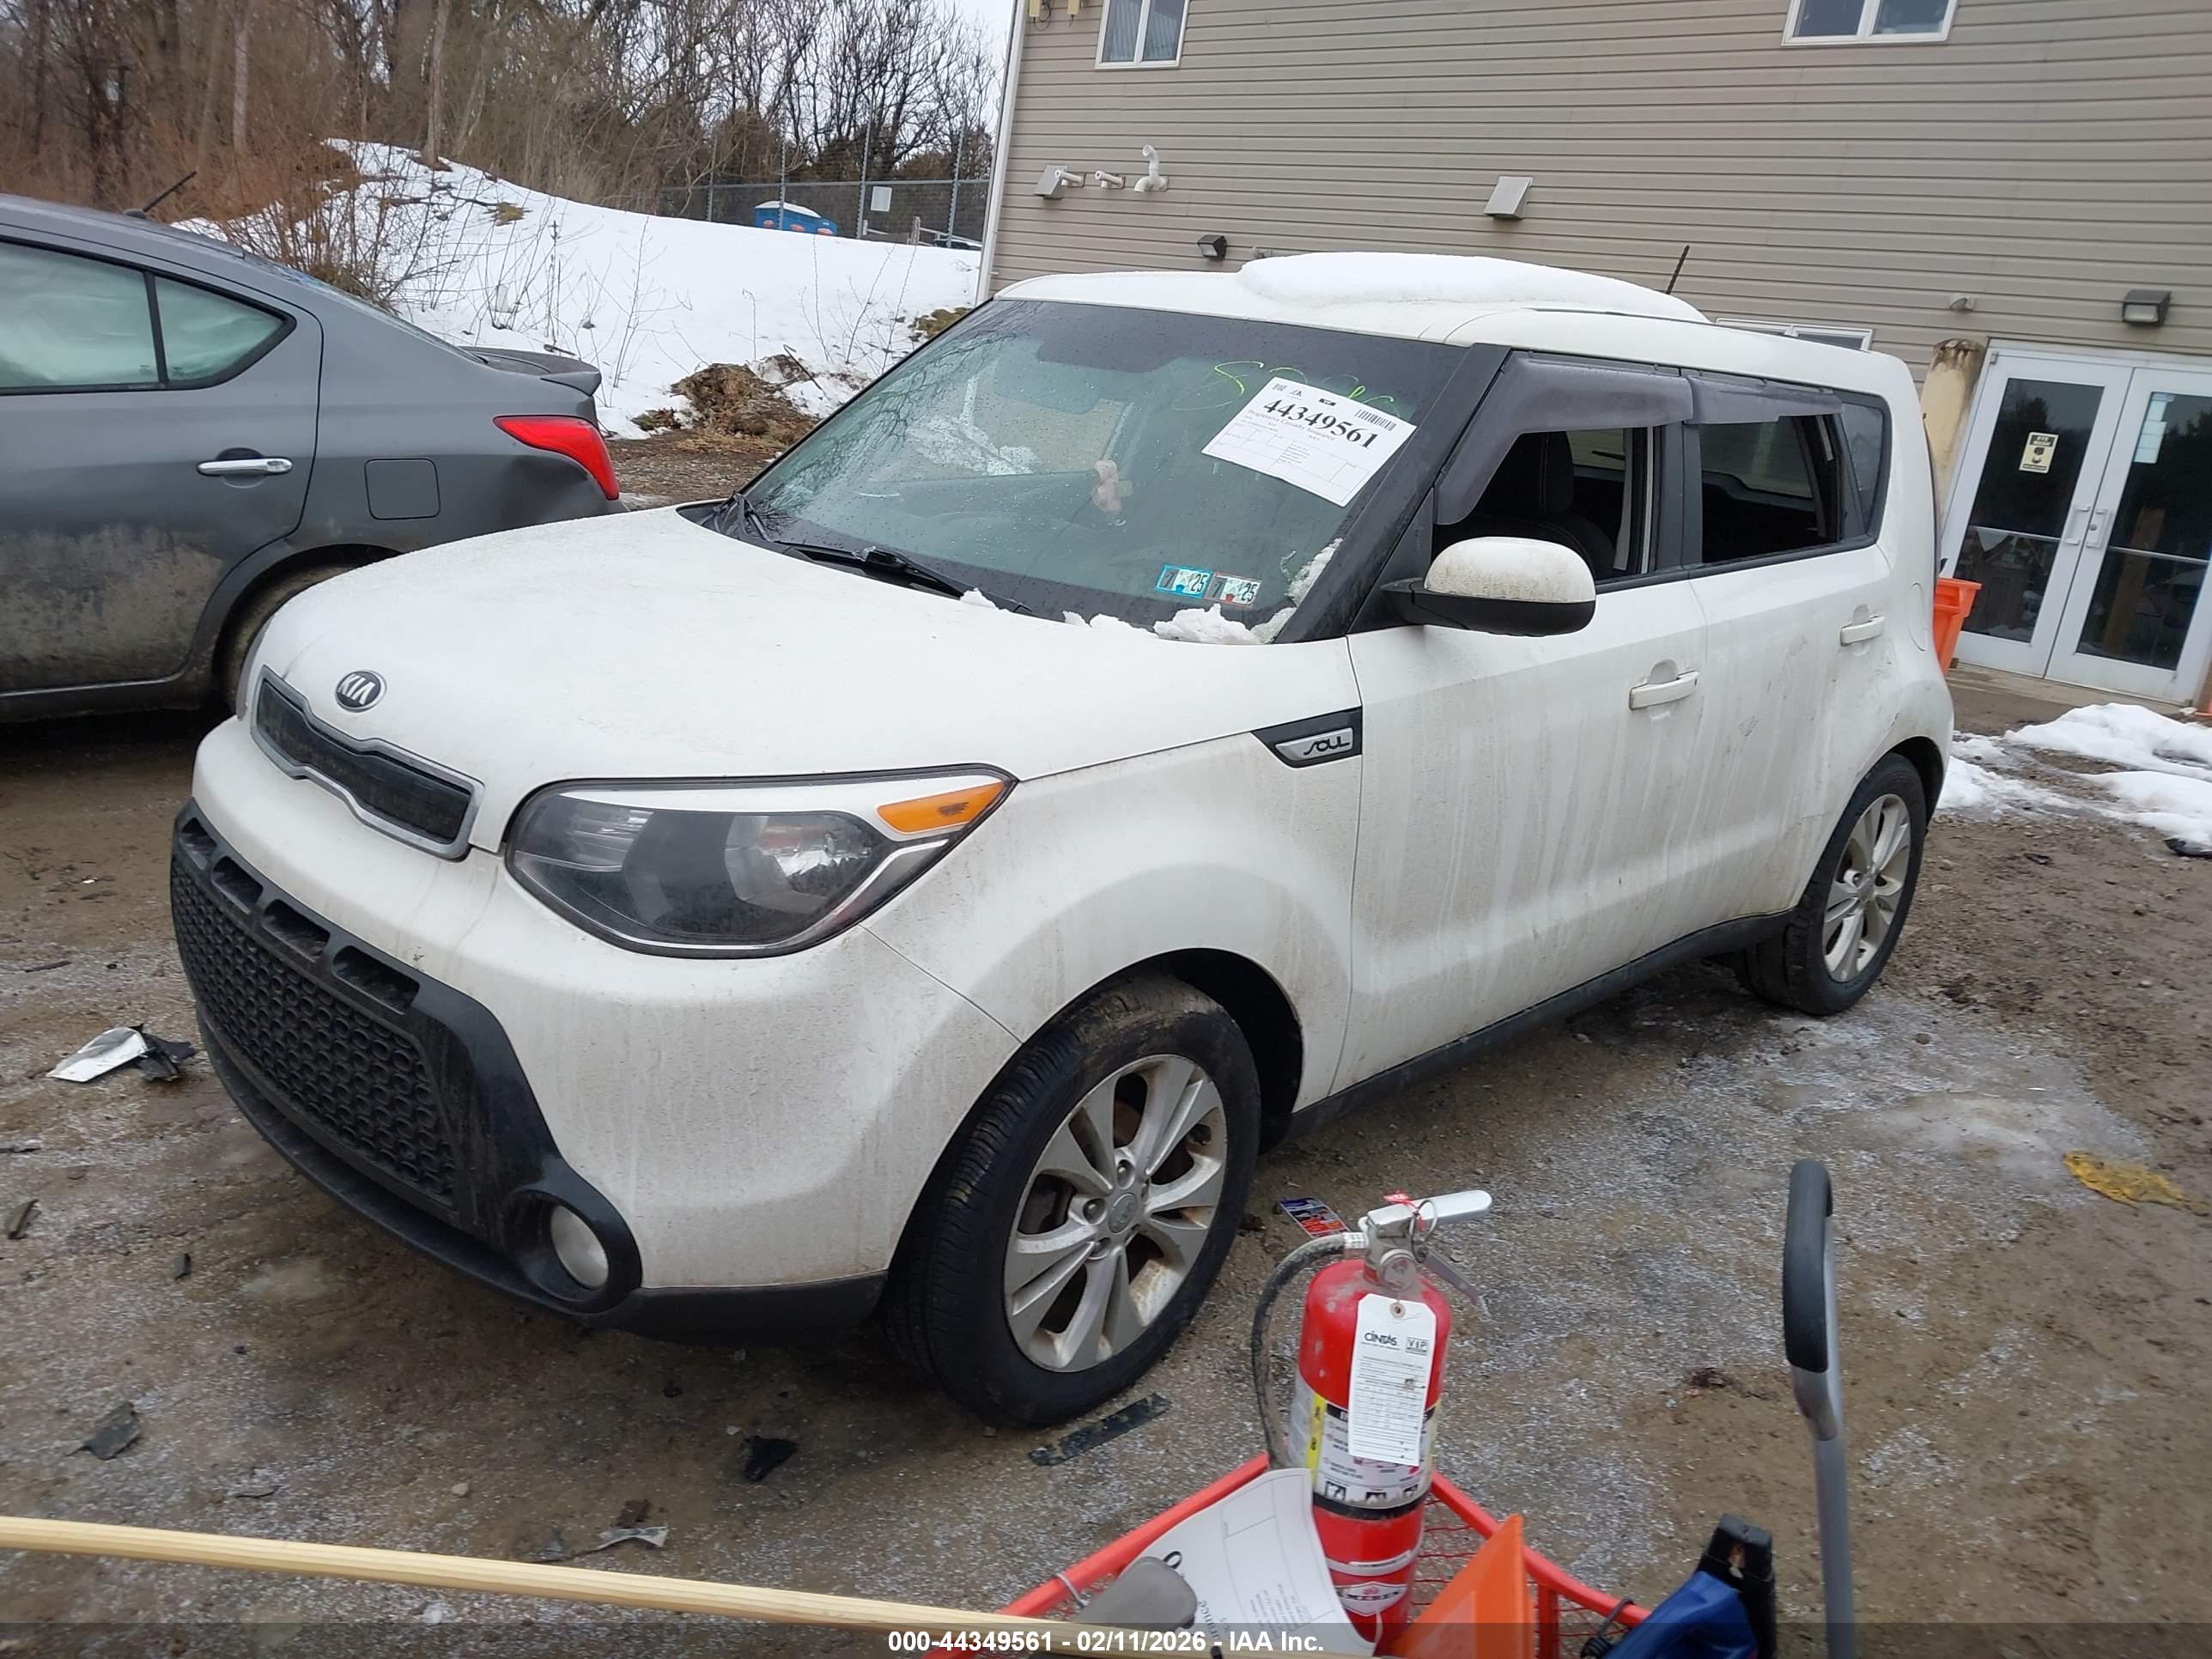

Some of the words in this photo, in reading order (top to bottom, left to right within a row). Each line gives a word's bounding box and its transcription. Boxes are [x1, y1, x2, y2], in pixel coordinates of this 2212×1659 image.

[1263, 399, 1377, 448] 44349561
[1191, 574, 1207, 592] 25
[1242, 582, 1257, 603] 25
[1407, 1339, 1428, 1349] VIP
